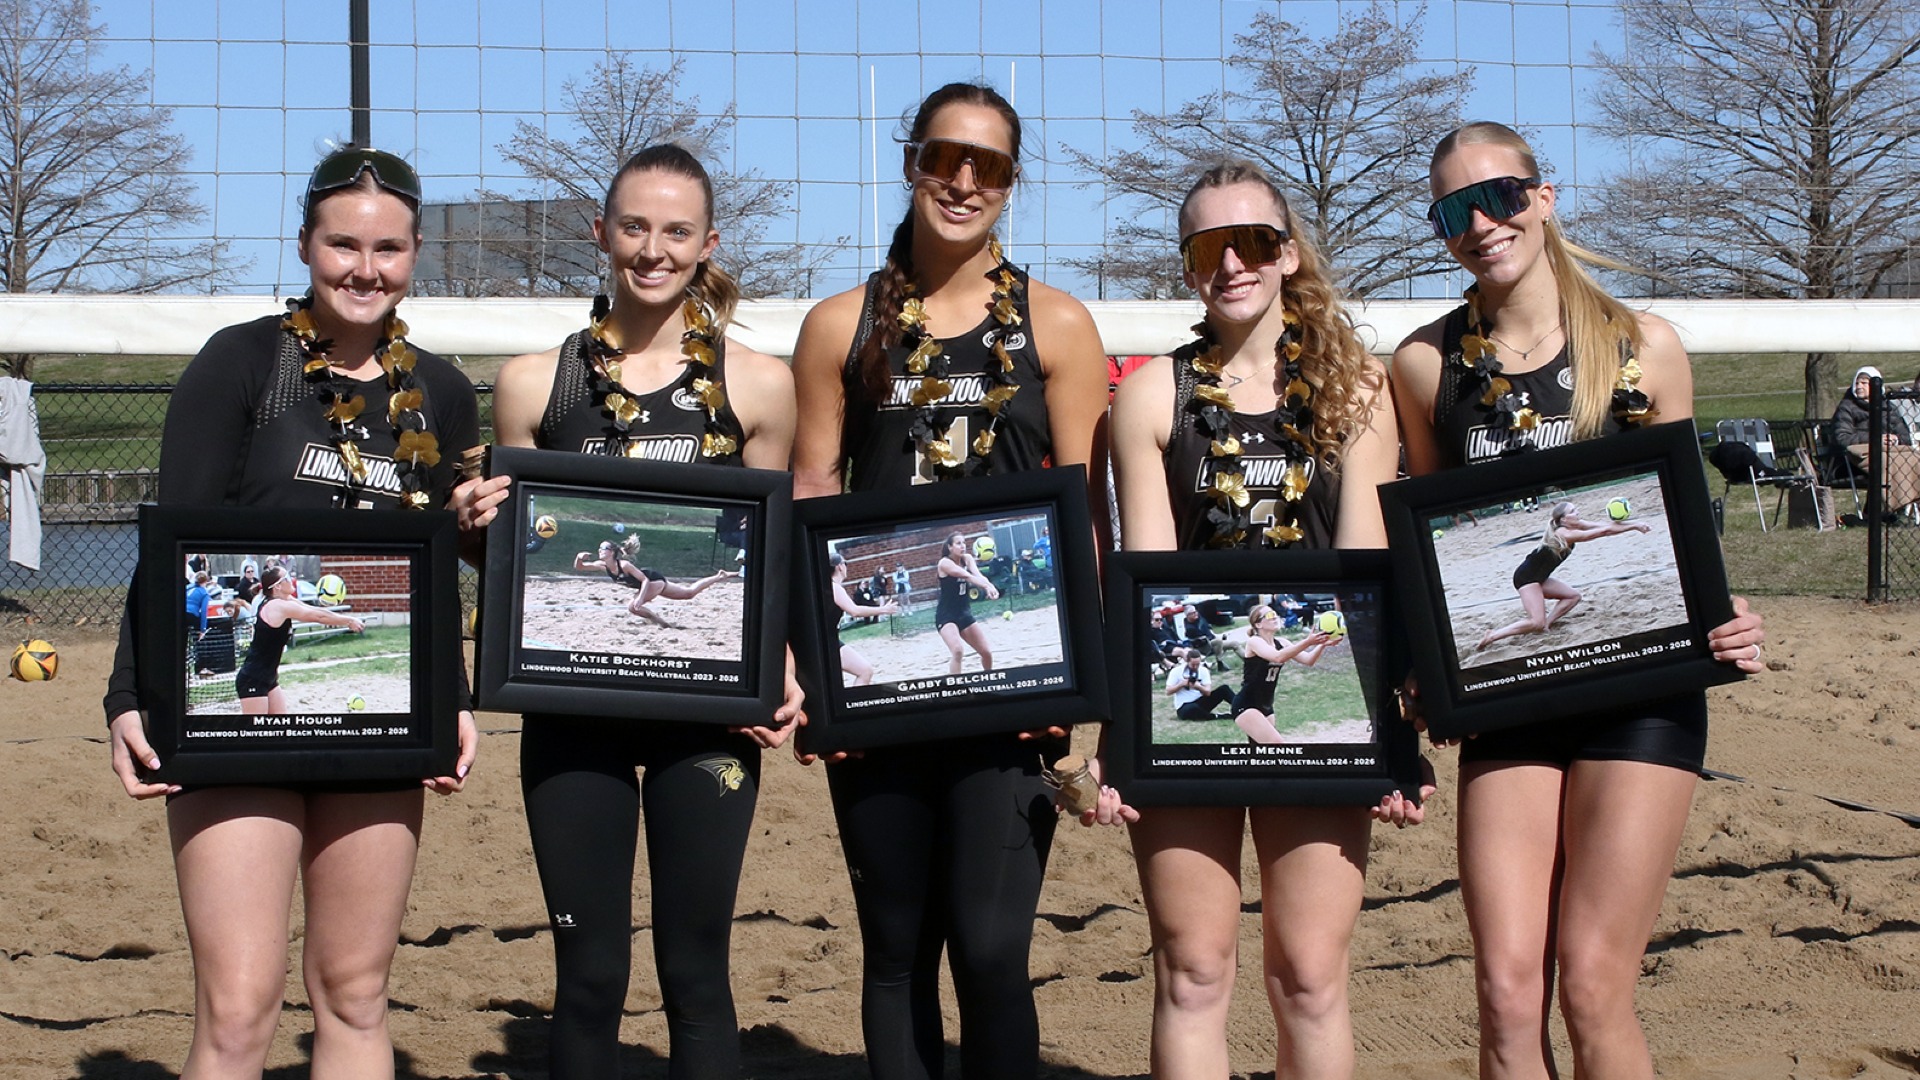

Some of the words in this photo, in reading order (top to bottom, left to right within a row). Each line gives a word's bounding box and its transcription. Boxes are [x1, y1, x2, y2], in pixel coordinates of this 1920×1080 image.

[569, 653, 609, 665] KATIE
[612, 655, 692, 669] BOCKHORST
[1526, 653, 1564, 668] NYAH
[1566, 641, 1622, 659] WILSON
[521, 663, 572, 674] LINDENWOOD
[572, 666, 617, 676] UNIVERSITY
[618, 668, 645, 677] BEACH
[645, 670, 692, 680] VOLLEYBALL
[692, 672, 714, 681] 2023
[718, 674, 739, 683] 2026
[1464, 675, 1516, 692] LINDENWOOD
[1516, 666, 1562, 681] UNIVERSITY
[1563, 660, 1591, 672] BEACH
[1591, 651, 1641, 665] VOLLEYBALL
[1641, 645, 1664, 656] 2023
[1669, 639, 1692, 650] 2026
[897, 679, 942, 692] GABBY
[945, 671, 1007, 686] BELCHER
[845, 697, 896, 709] LINDENWOOD
[897, 691, 940, 703] UNIVERSITY
[941, 688, 968, 698] BEACH
[968, 683, 1015, 694] VOLLEYBALL
[1016, 679, 1038, 689] 2025
[1042, 676, 1064, 686] 2026
[253, 715, 291, 726] MYAH
[295, 715, 343, 725] HOUGH
[186, 729, 239, 738] LINDENWOOD
[239, 729, 285, 738] UNIVERSITY
[285, 728, 313, 737] BEACH
[313, 728, 361, 737] VOLLEYBALL
[361, 727, 383, 736] 2023
[387, 727, 409, 735] 2026
[1221, 746, 1251, 755] LEXI
[1255, 746, 1304, 755] MENNE
[1152, 758, 1203, 766] LINDENWOOD
[1204, 758, 1249, 766] UNIVERSITY
[1250, 758, 1276, 766] BEACH
[1277, 758, 1325, 766] VOLLEYBALL
[1326, 758, 1349, 766] 2024
[1353, 757, 1376, 766] 2026
